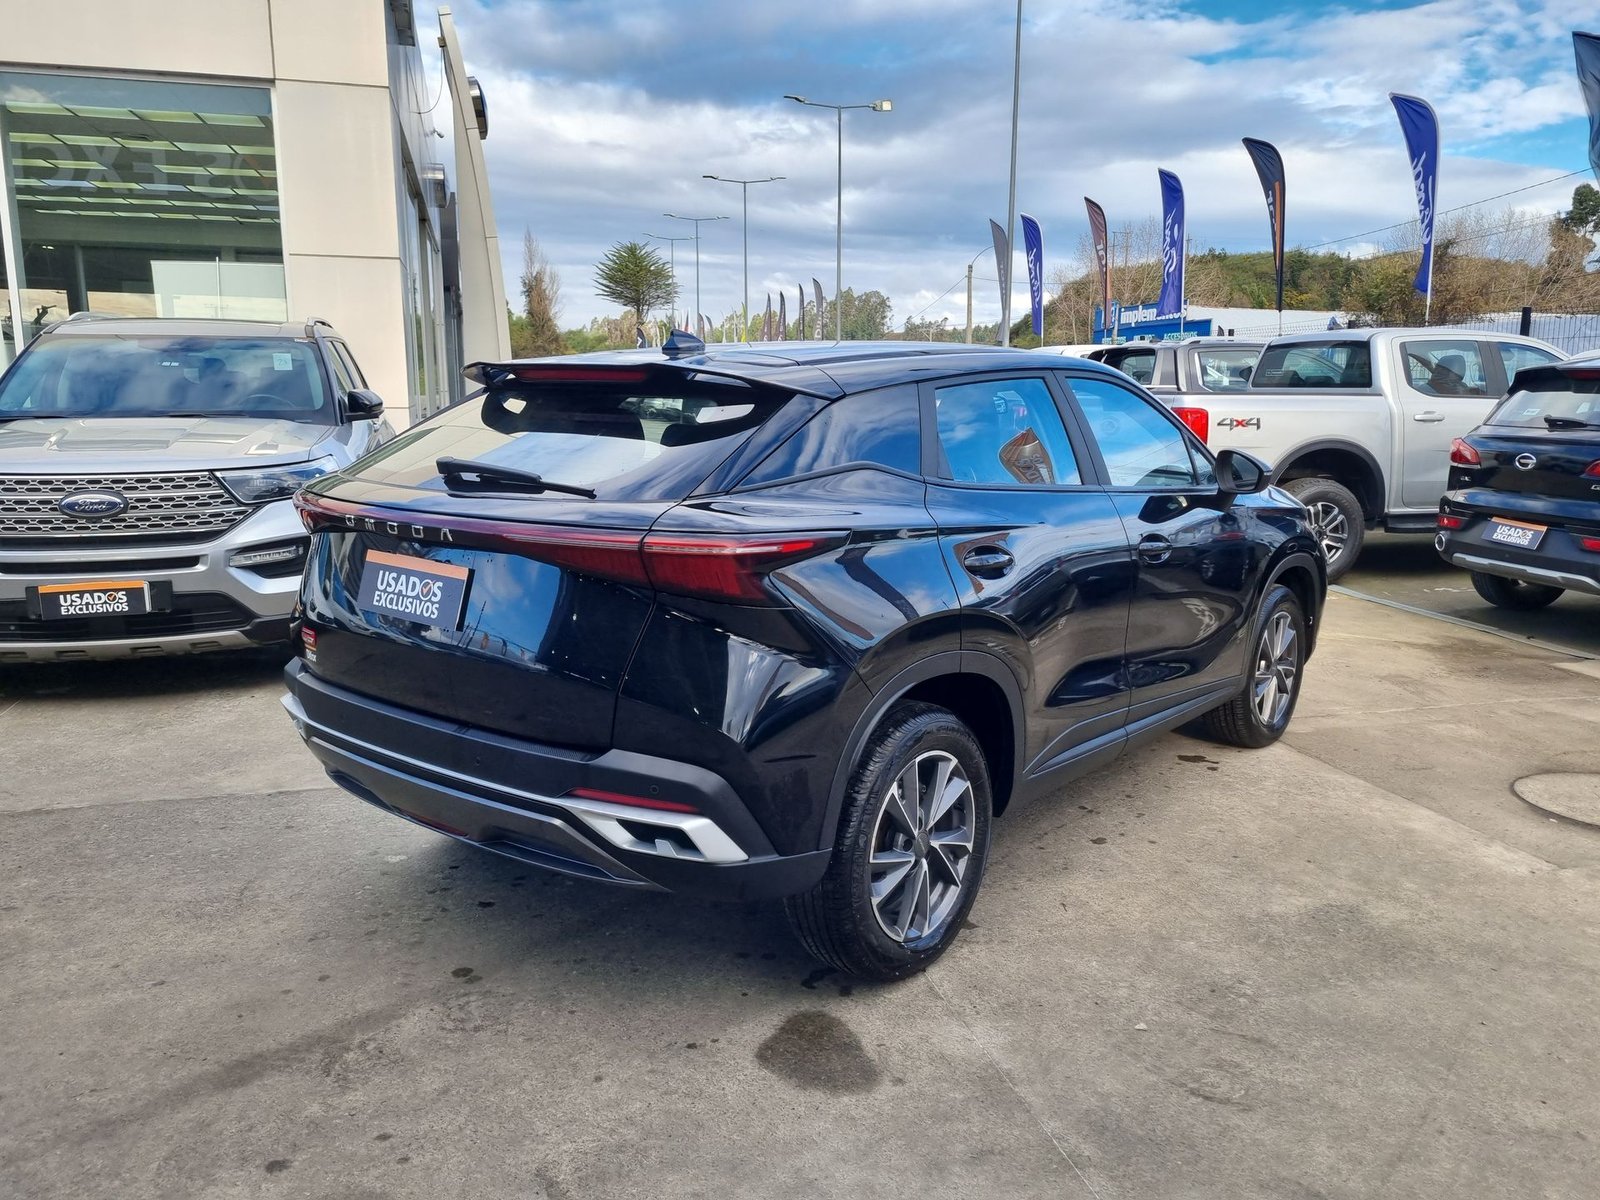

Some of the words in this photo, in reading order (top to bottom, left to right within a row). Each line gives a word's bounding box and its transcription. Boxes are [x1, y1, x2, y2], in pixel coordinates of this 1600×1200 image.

[74, 499, 111, 511] Ford
[1492, 532, 1529, 545] EXCLUSIVOS
[1496, 525, 1534, 539] USADOS
[377, 570, 443, 602] USADOS
[59, 591, 127, 606] USADOS
[373, 590, 439, 619] EXCLUSIVOS
[60, 603, 129, 615] EXCLUSIVOS
